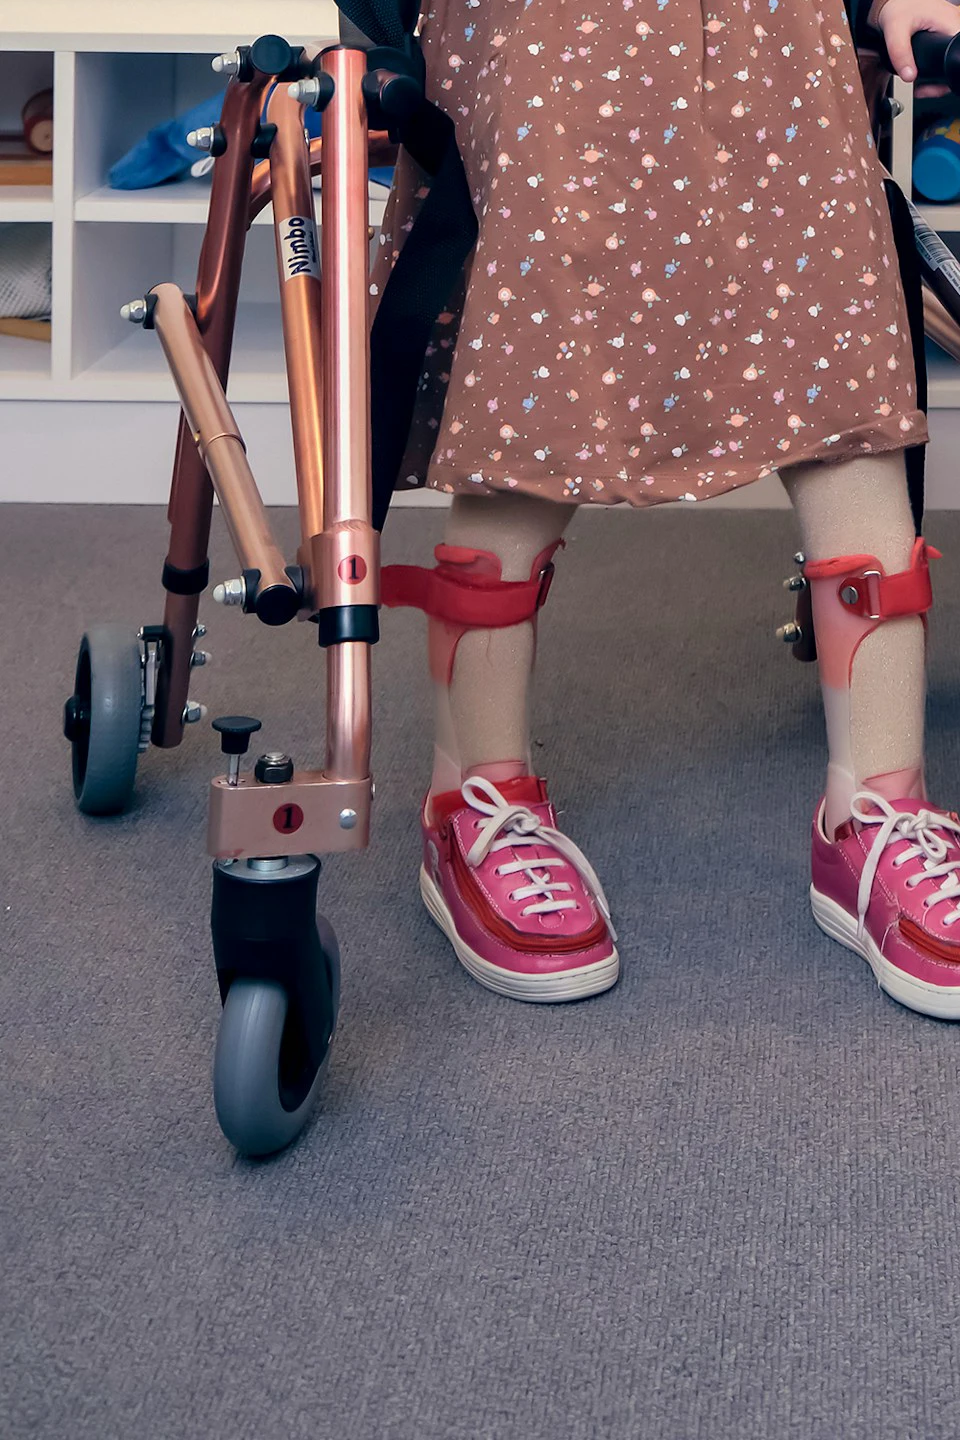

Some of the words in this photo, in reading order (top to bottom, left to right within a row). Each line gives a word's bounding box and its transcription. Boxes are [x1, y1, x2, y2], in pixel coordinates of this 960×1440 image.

[283, 217, 312, 276] Nimbo
[348, 557, 361, 580] 1
[282, 806, 296, 829] 1
